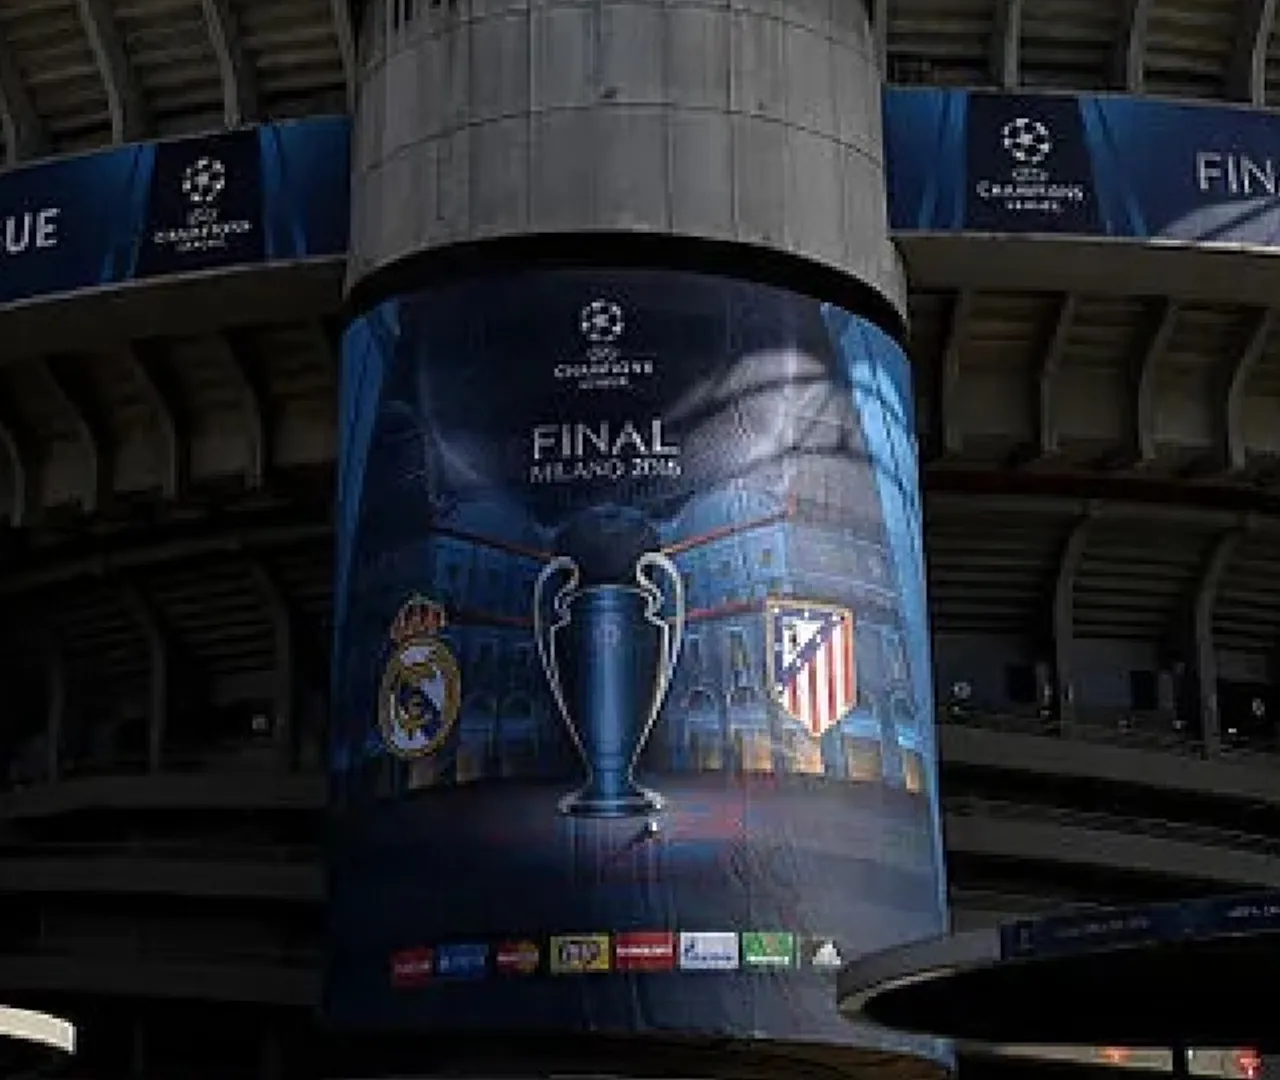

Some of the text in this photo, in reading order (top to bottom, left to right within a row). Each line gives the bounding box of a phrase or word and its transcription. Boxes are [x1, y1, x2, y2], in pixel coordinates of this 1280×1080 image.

[532, 419, 681, 461] FINAL
[530, 456, 682, 484] MILANO 2016
